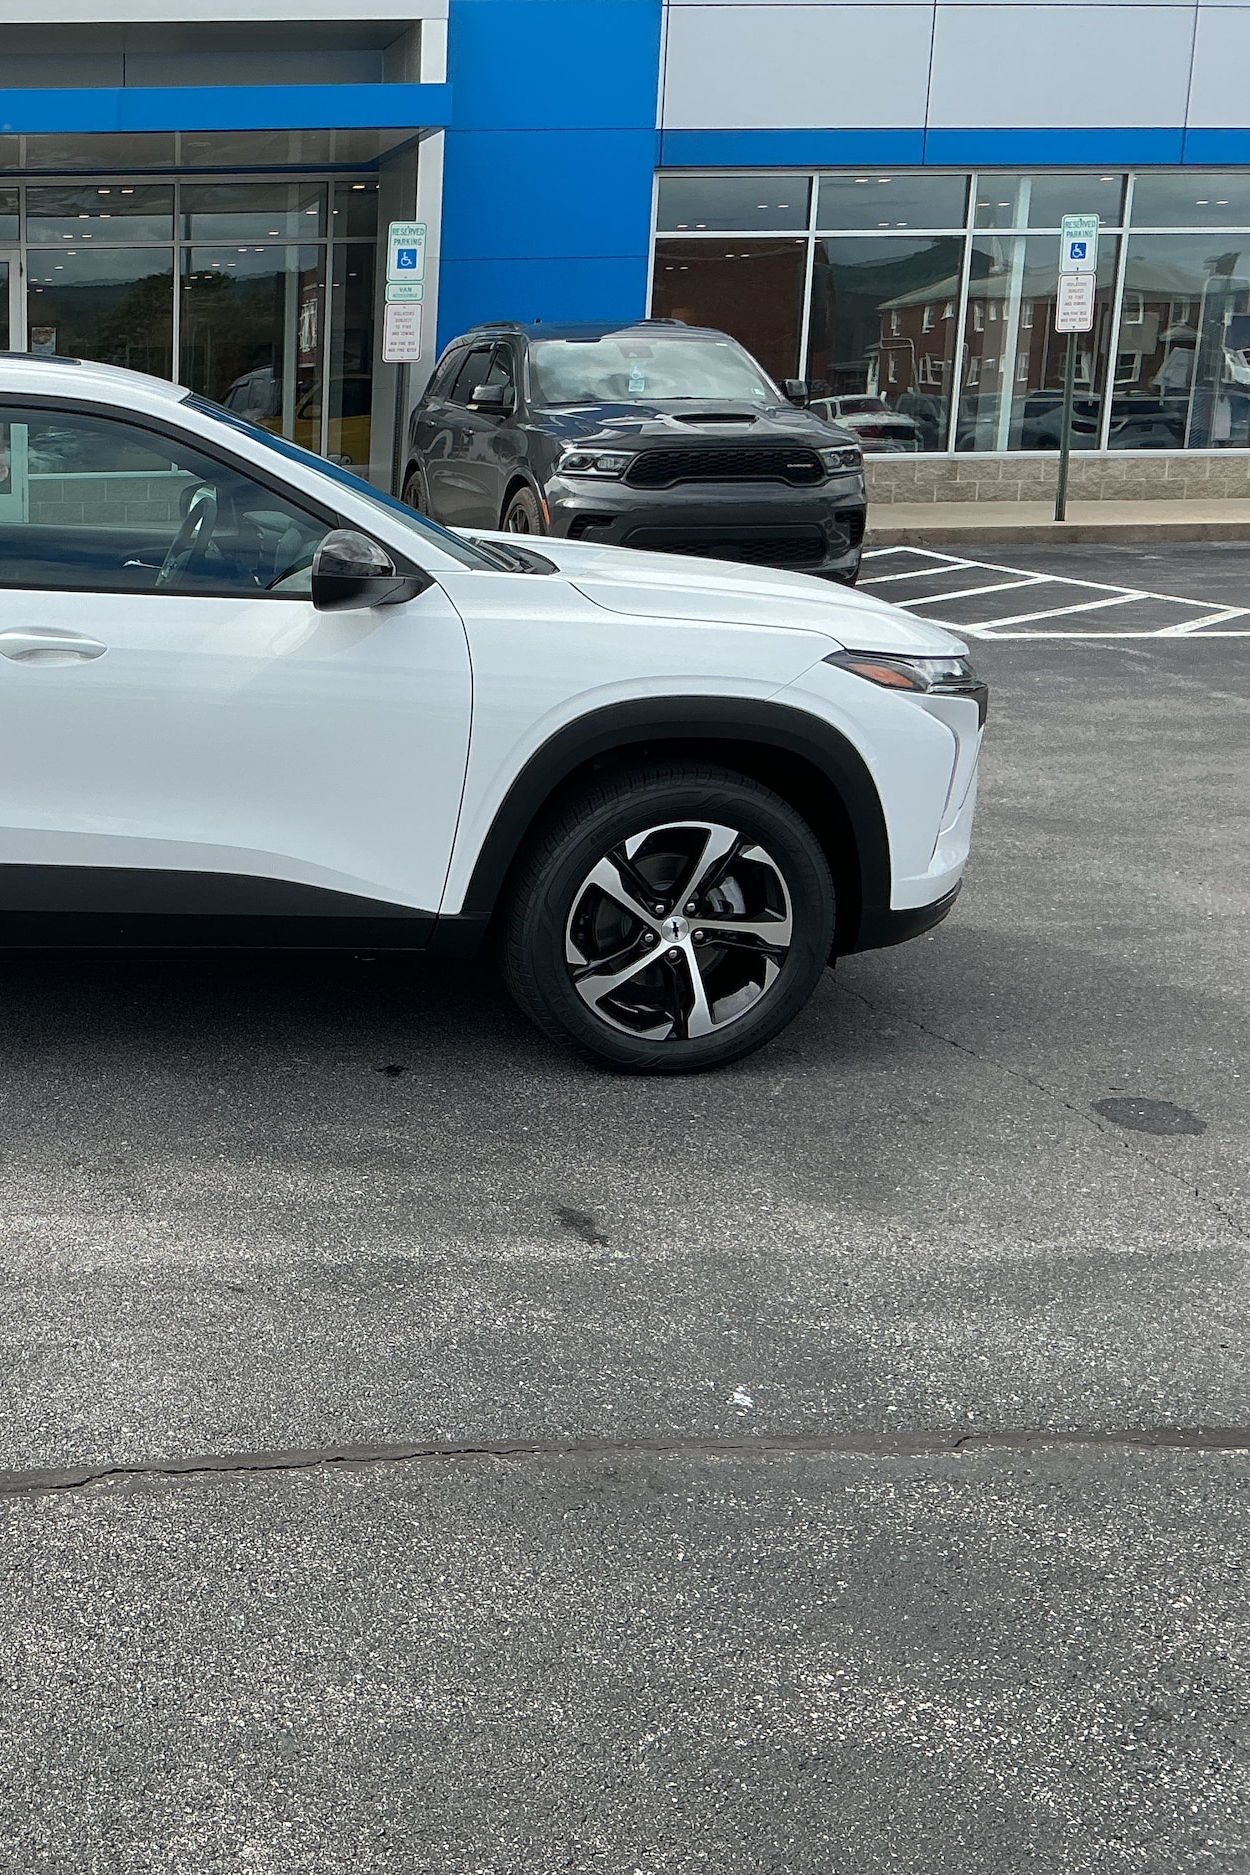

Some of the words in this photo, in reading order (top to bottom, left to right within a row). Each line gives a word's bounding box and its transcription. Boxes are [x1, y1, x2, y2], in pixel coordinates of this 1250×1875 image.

[1064, 220, 1096, 228] RESERVED
[392, 227, 425, 236] RESERVED
[1066, 230, 1094, 238] PARKING
[393, 238, 423, 246] PARKING
